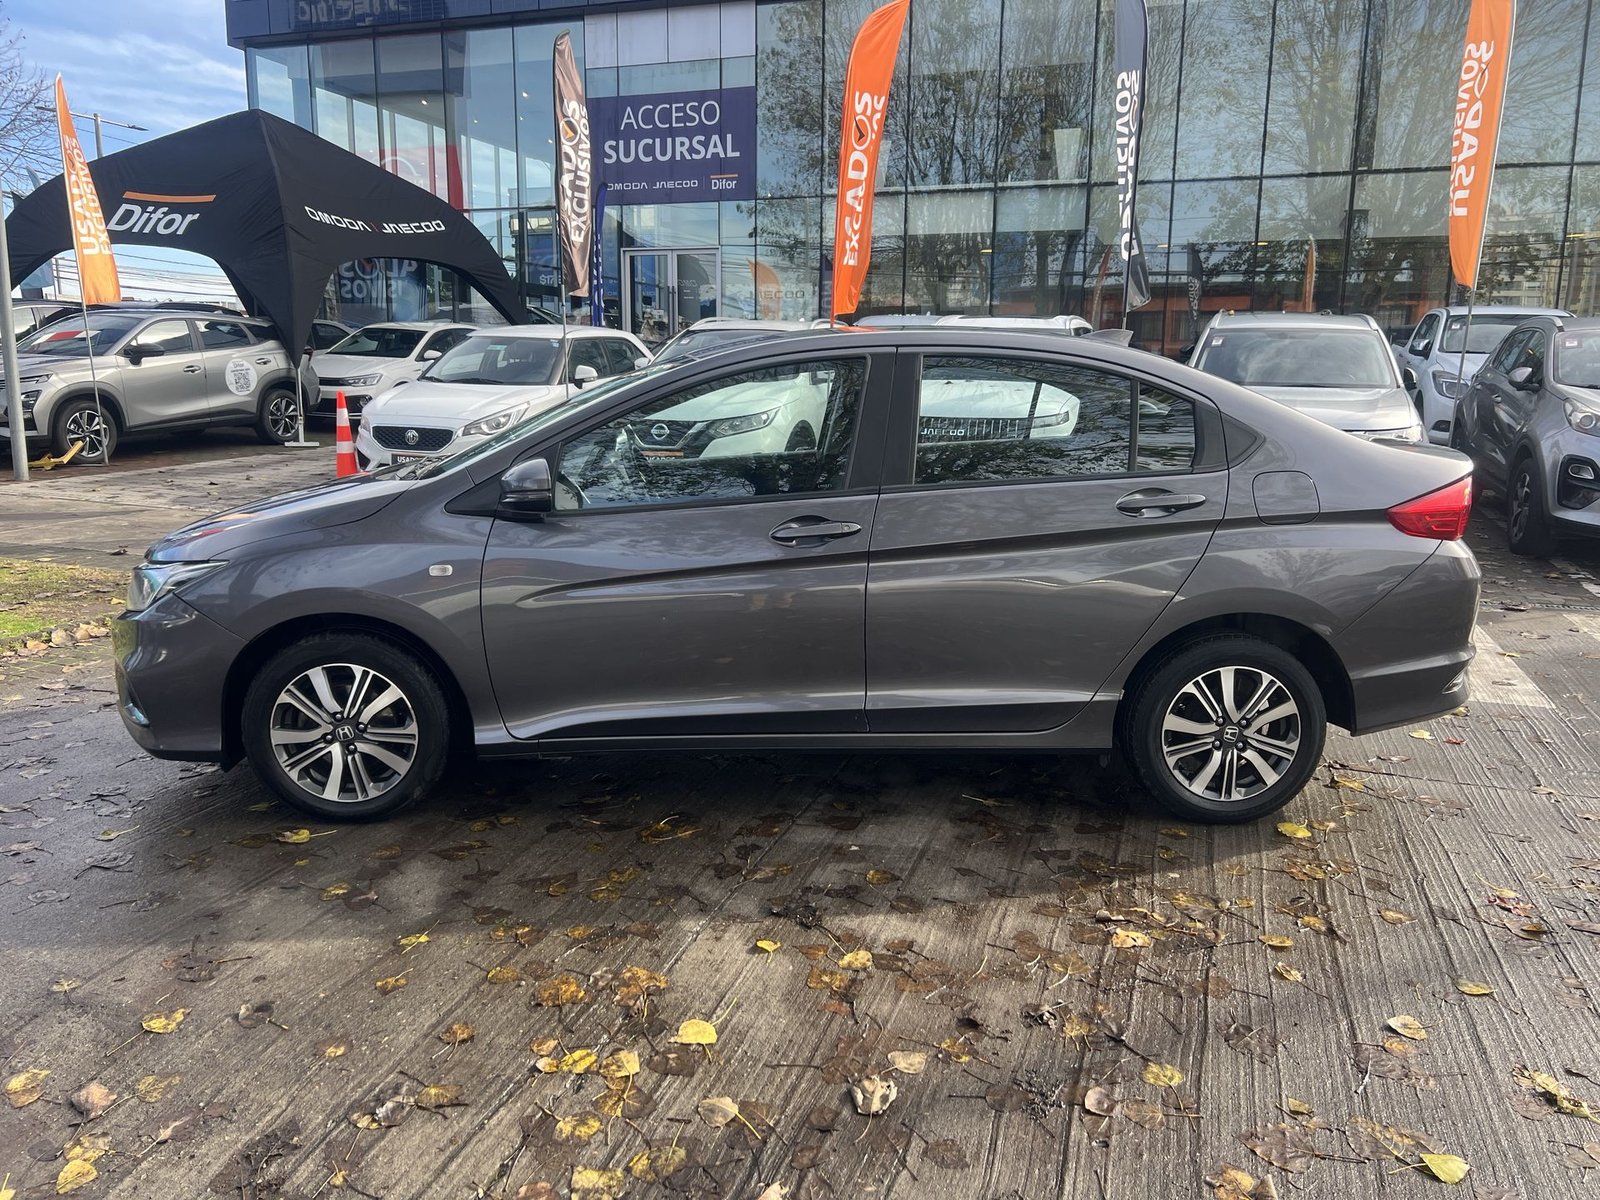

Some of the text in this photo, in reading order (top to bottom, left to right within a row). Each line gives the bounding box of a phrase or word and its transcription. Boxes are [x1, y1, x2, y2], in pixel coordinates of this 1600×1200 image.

[620, 100, 720, 130] ACCESO
[603, 133, 740, 164] SUCURSAL
[571, 104, 591, 243] EXCLUSIVOS
[606, 179, 737, 191] OMODA JAECOO Difor
[106, 203, 200, 235] Difor
[304, 206, 446, 234] OMODA JAECOO
